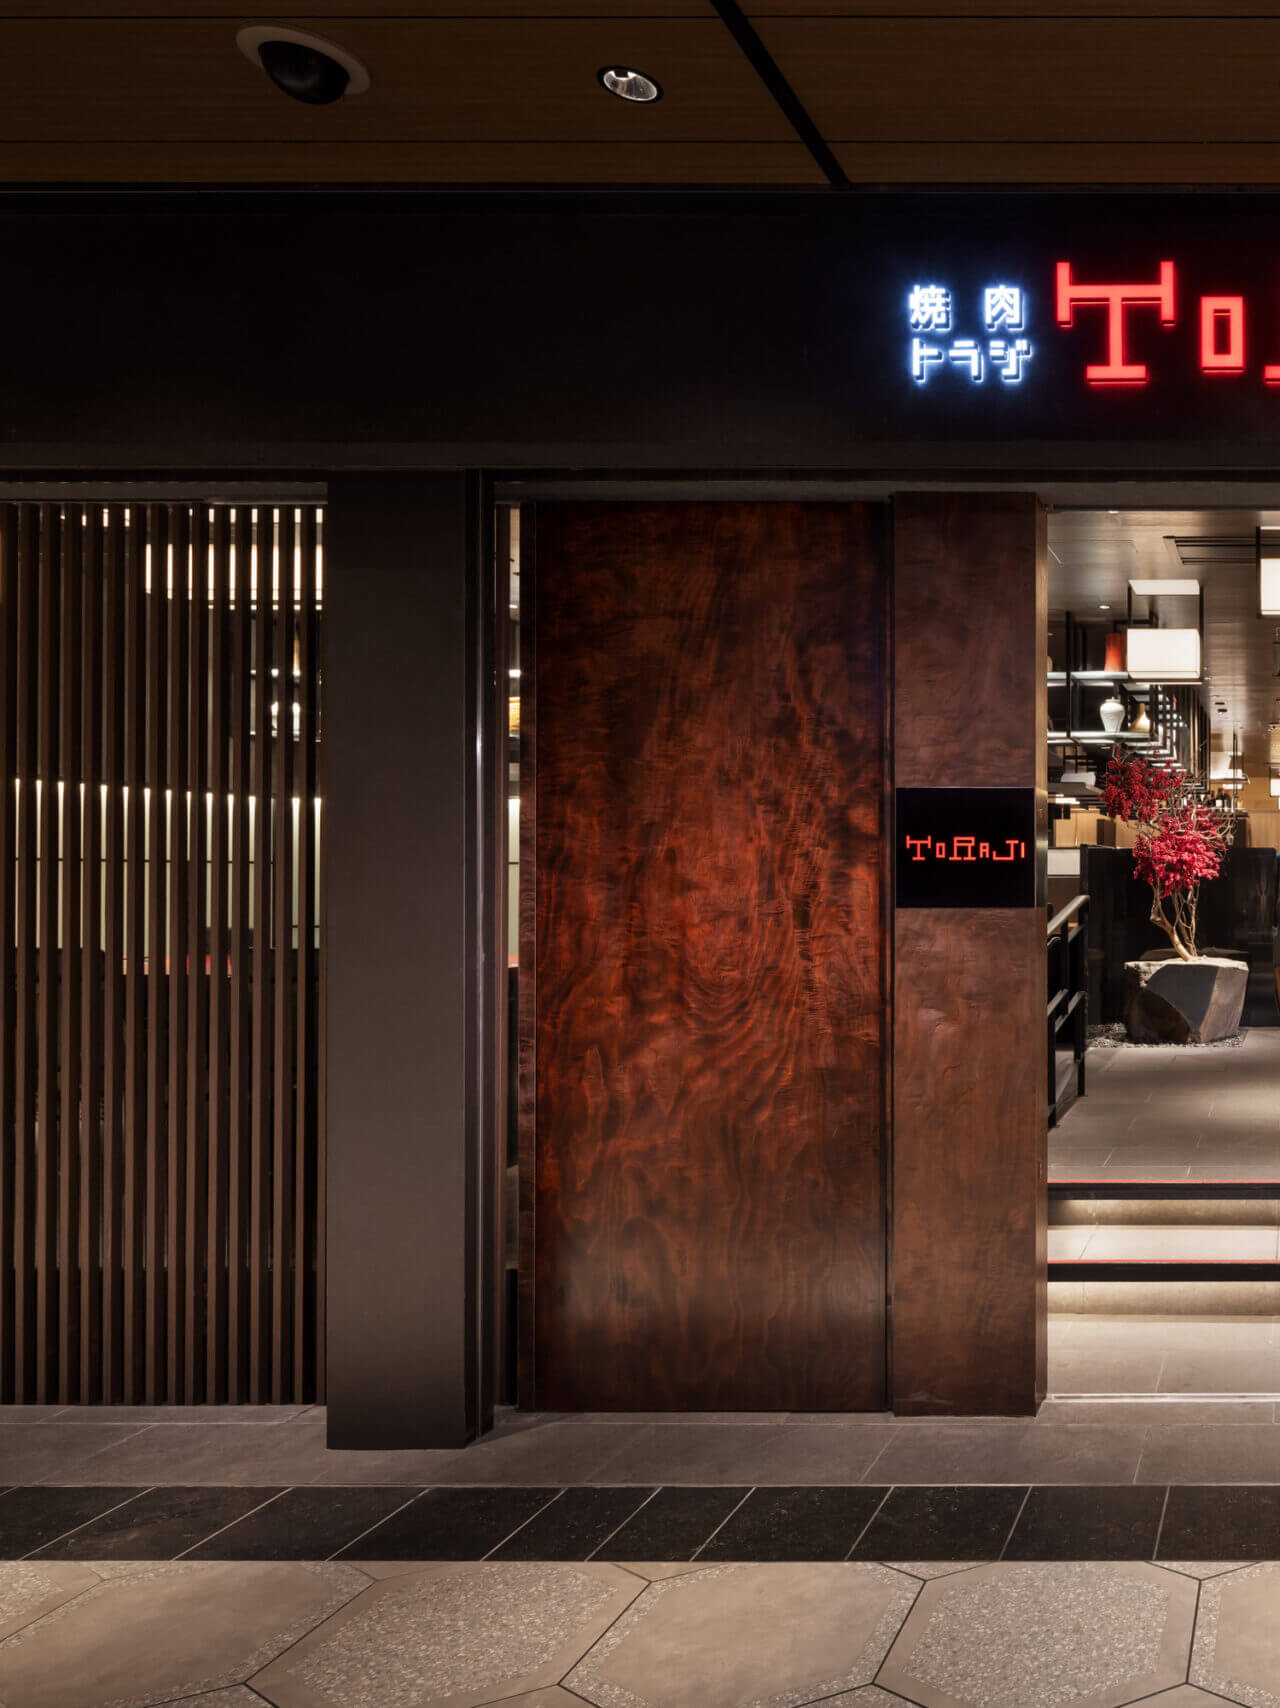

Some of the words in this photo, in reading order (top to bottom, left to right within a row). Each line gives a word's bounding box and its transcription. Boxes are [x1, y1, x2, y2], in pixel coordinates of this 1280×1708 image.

[911, 338, 1031, 382] トラジ
[906, 834, 1025, 861] TORAJI
